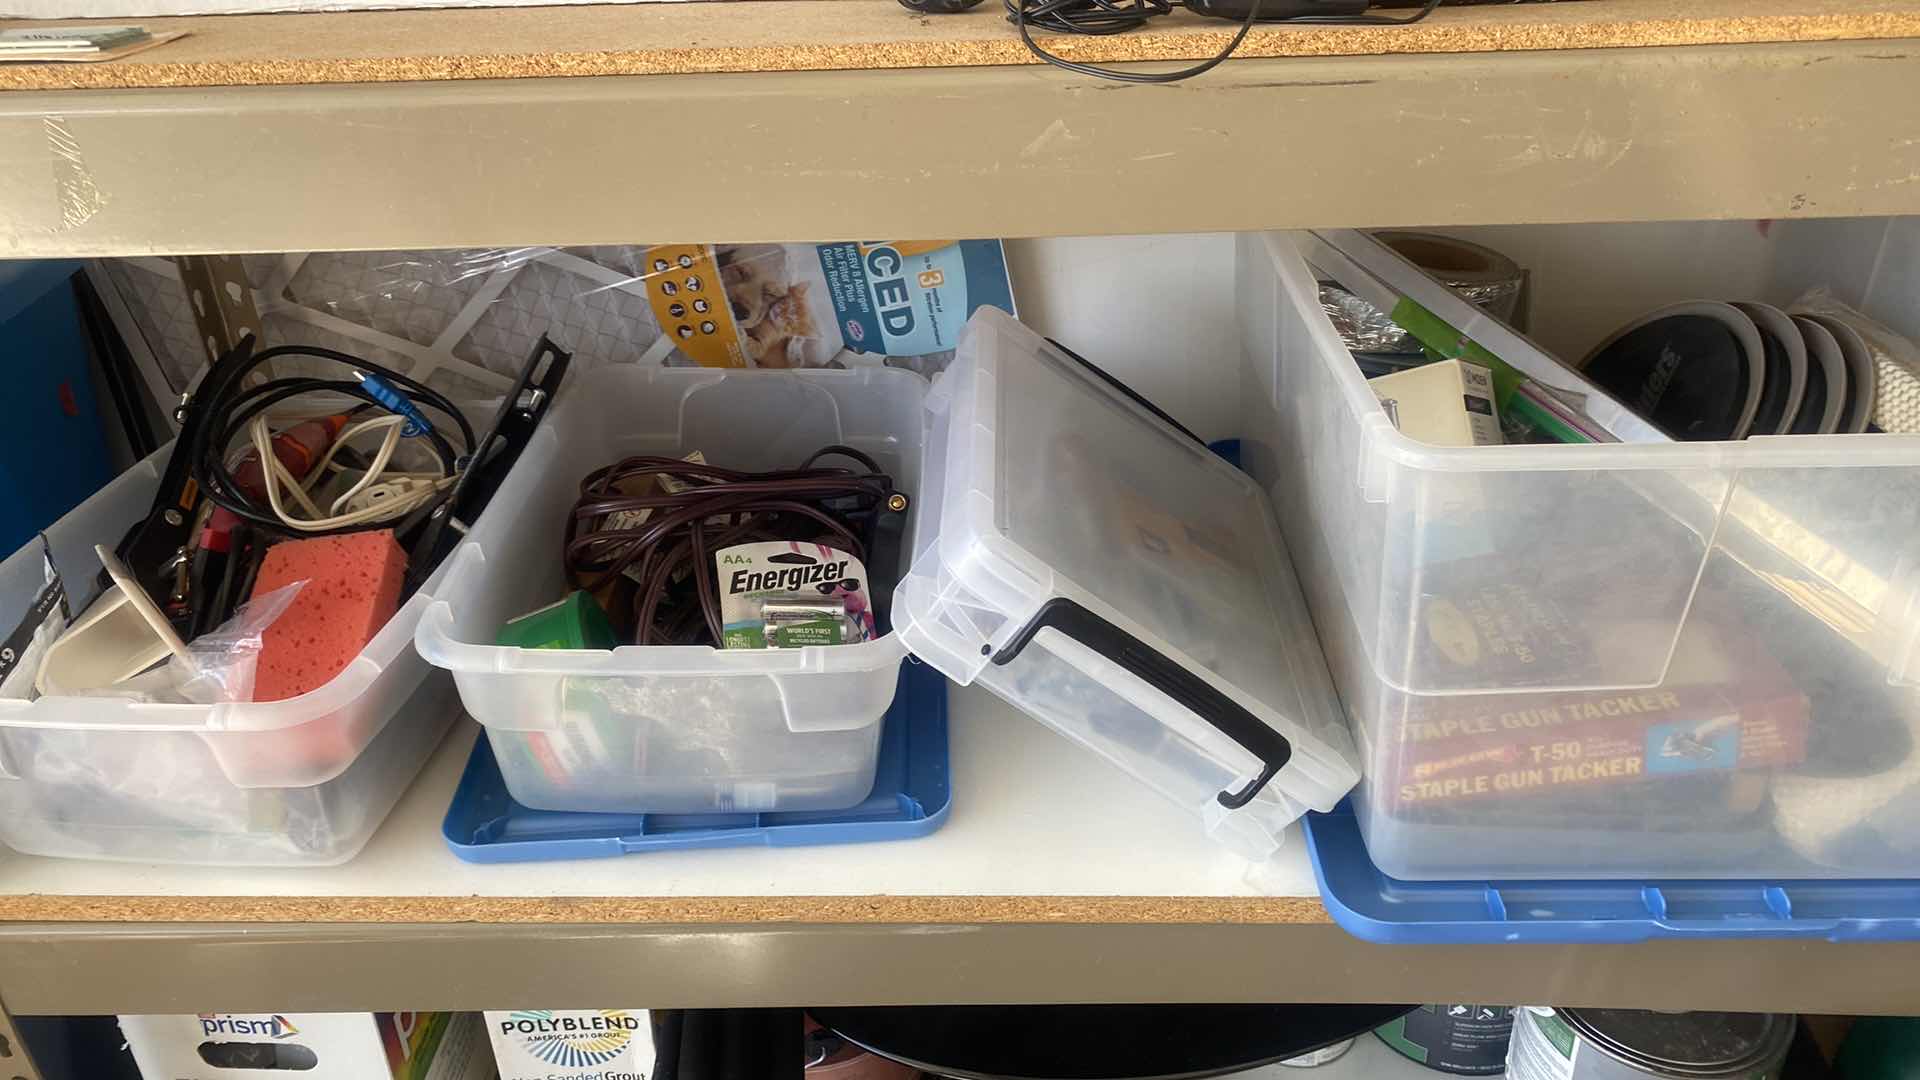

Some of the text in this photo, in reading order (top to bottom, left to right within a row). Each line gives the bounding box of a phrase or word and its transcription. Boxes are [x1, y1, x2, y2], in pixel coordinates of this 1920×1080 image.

[828, 270, 847, 312] Reduction
[866, 242, 915, 336] CED
[920, 272, 942, 286] 3
[729, 561, 848, 594] Energizer
[1501, 707, 1562, 730] GUN
[1568, 692, 1682, 721] TACKER
[1529, 741, 1582, 764] T-50
[1401, 756, 1643, 801] STAPLE GUN TACKER
[202, 1015, 272, 1036] prism
[501, 1017, 639, 1035] POLYBLEND
[527, 1033, 577, 1042] AMERICA'S
[590, 1031, 621, 1039] GROUT
